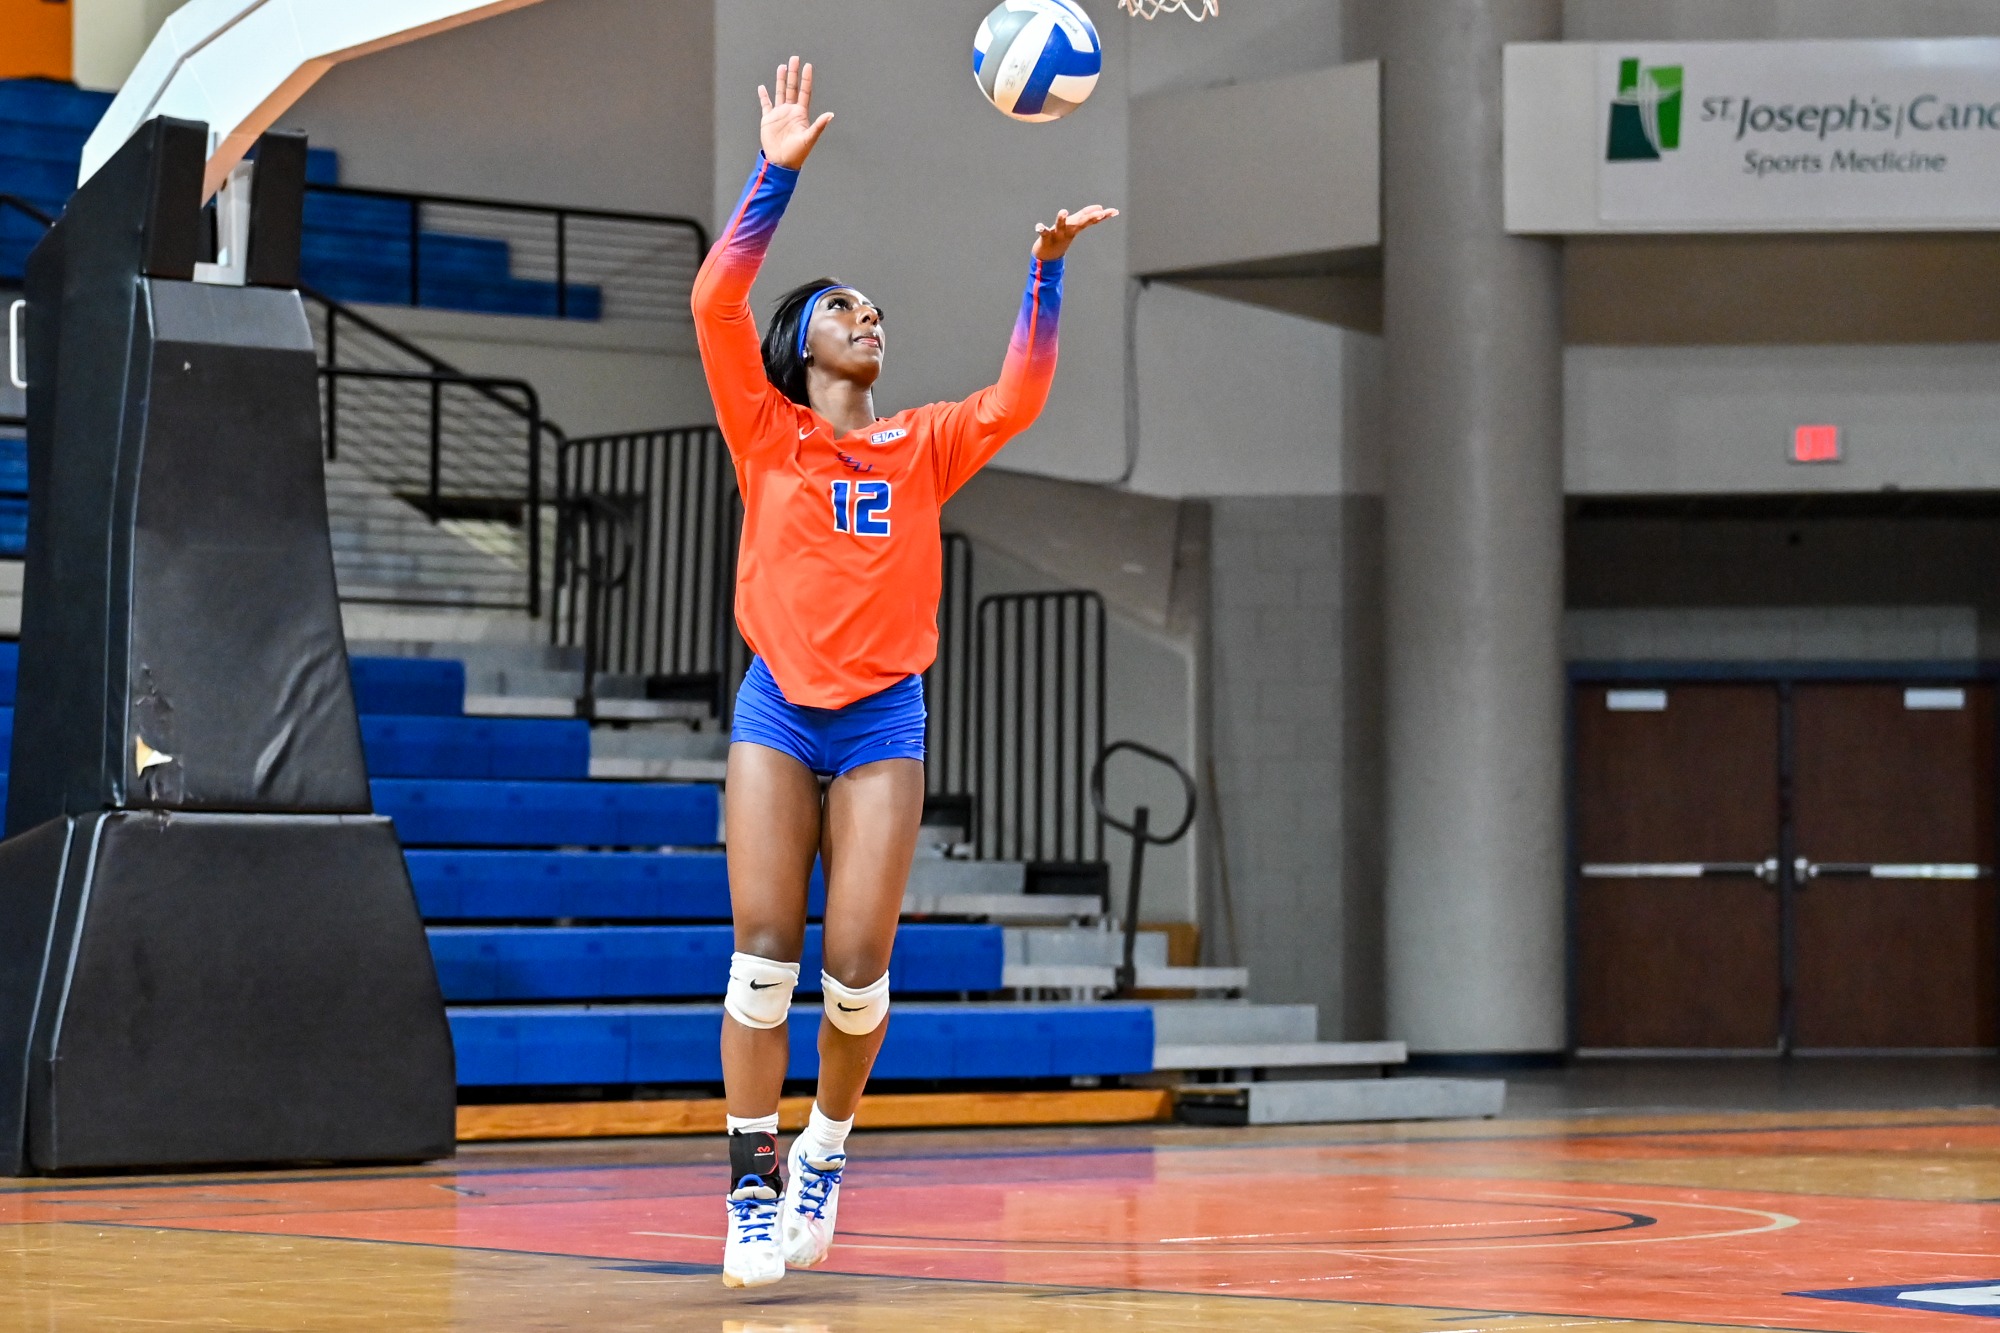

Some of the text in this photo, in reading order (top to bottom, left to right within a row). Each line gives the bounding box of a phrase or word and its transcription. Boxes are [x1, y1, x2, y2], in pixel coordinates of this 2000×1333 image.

[1742, 149, 1947, 178] Sports Medicine
[831, 480, 891, 537] 12
